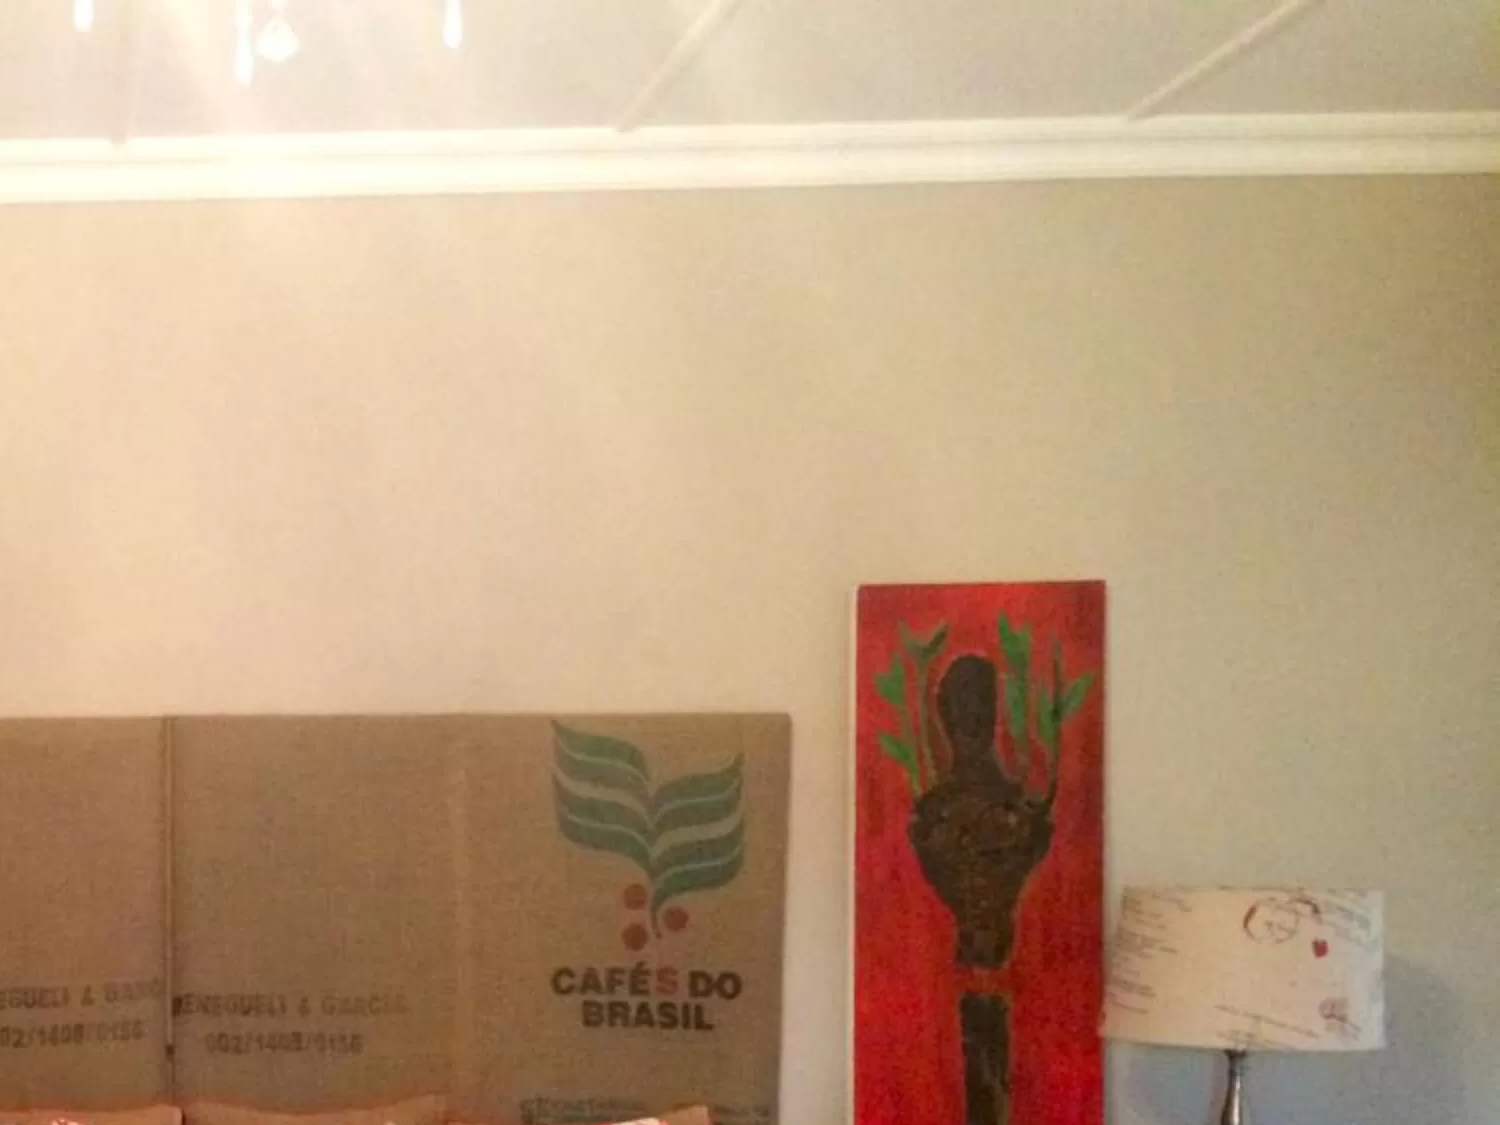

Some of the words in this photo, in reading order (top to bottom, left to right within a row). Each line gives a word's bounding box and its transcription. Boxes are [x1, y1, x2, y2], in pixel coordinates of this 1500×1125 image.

[551, 961, 679, 996] CAFÉS
[688, 970, 743, 1000] DO
[582, 1000, 716, 1031] BRASIL
